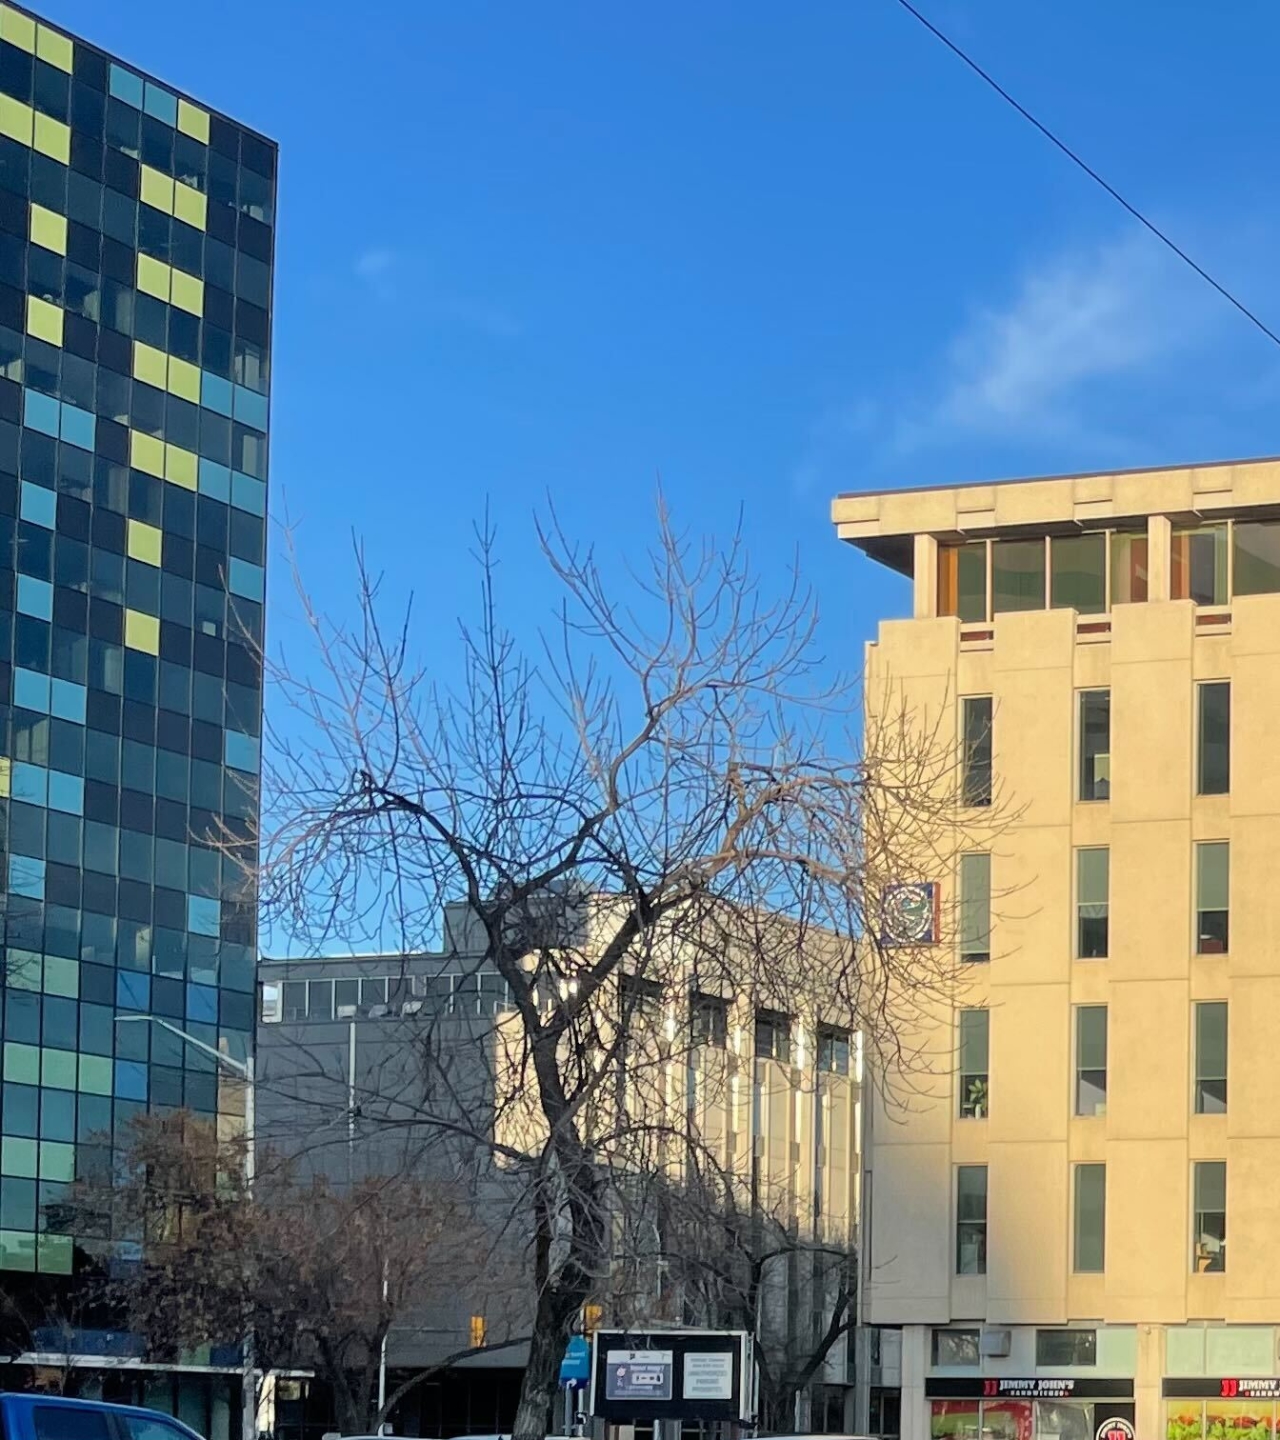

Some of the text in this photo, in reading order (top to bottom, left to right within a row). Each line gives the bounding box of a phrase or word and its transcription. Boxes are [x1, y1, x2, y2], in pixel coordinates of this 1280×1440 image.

[999, 1380, 1075, 1391] JIMMY JOHN'S
[1239, 1380, 1277, 1391] JIMMY
